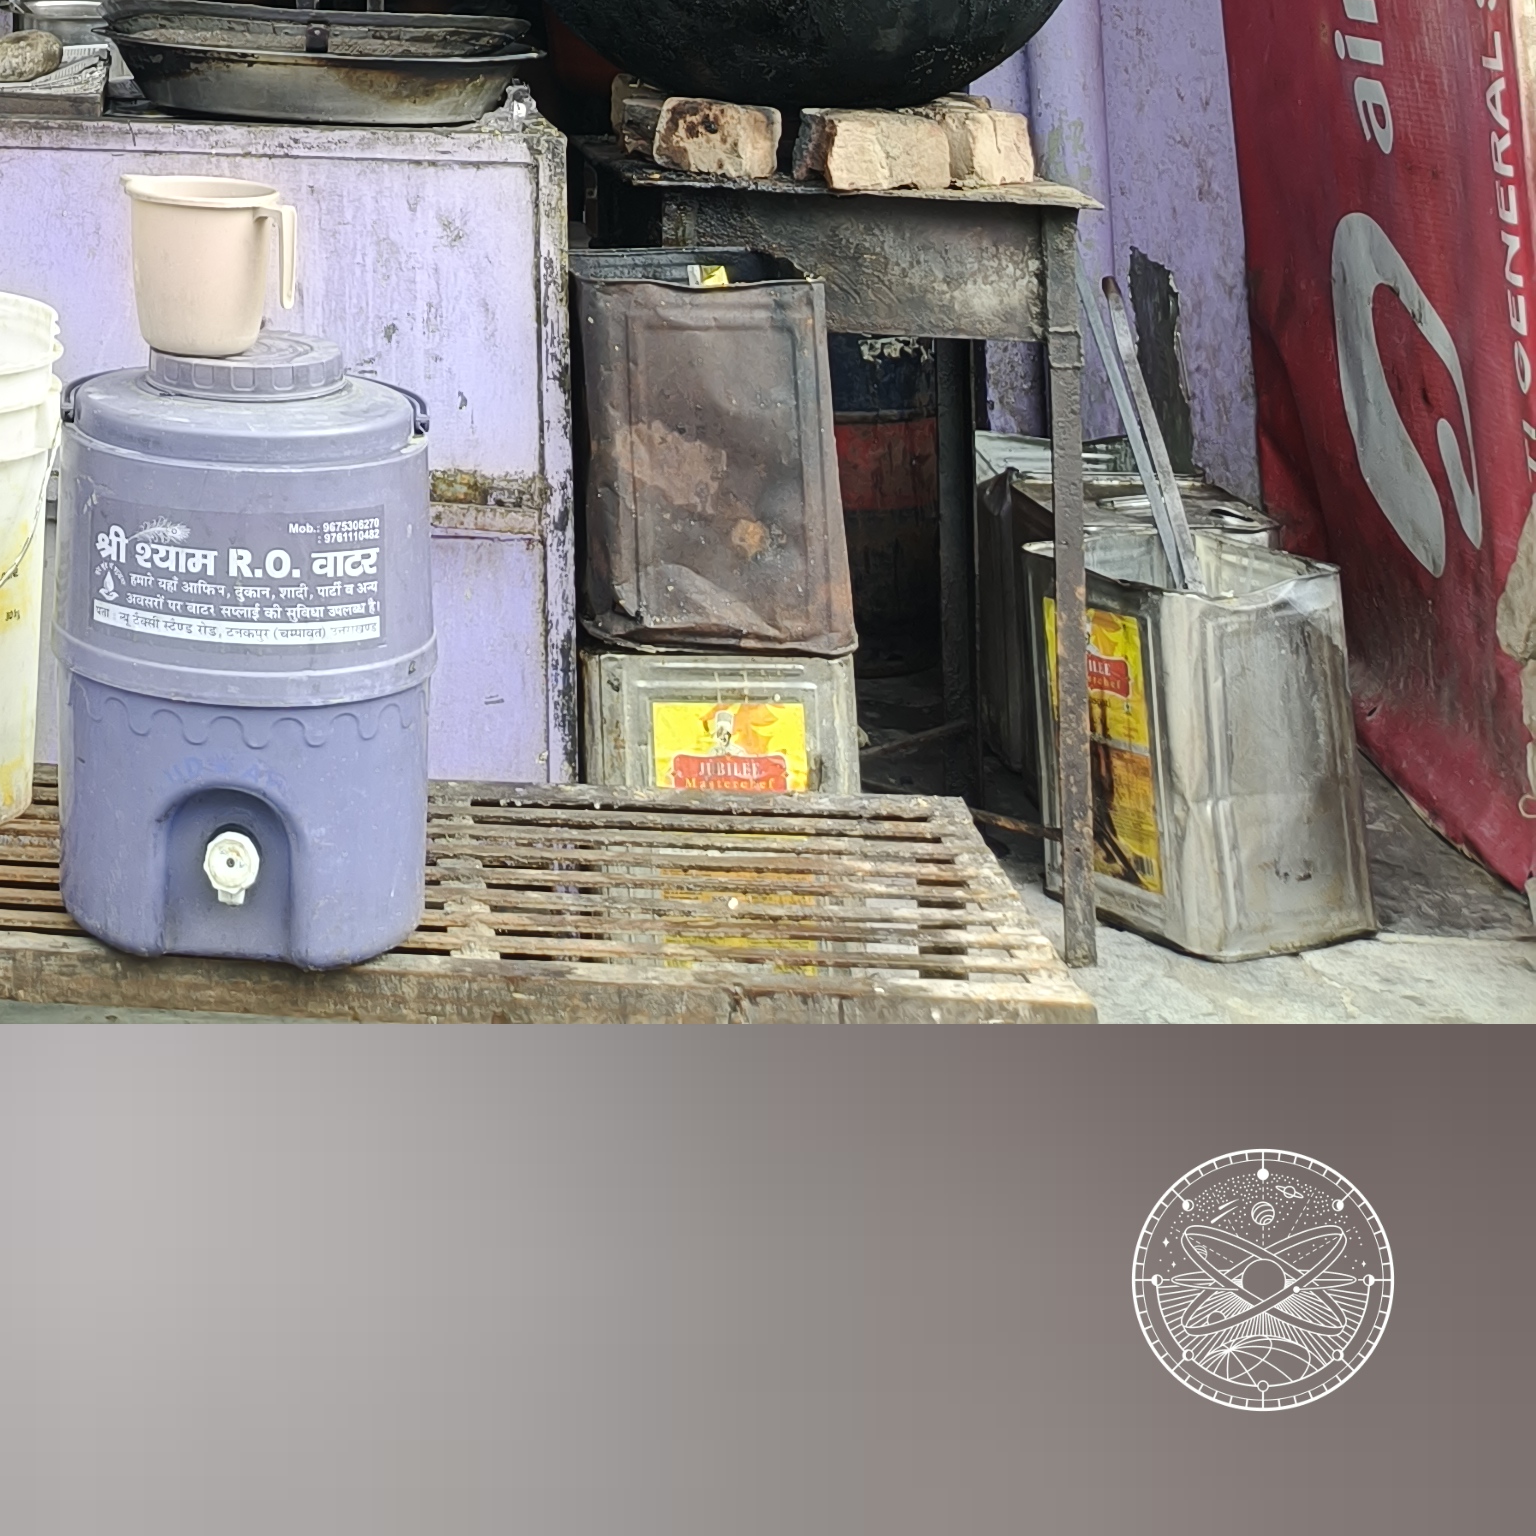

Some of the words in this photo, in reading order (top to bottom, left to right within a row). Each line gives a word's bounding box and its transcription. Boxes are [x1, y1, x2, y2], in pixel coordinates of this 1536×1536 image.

[1477, 26, 1535, 399] GENERAL
[95, 524, 129, 564] श्री
[135, 540, 218, 576] श्याम
[228, 548, 301, 579] R.O.
[311, 547, 381, 578] वाटर
[128, 573, 154, 587] हमारे
[699, 761, 760, 777] JUBILEE
